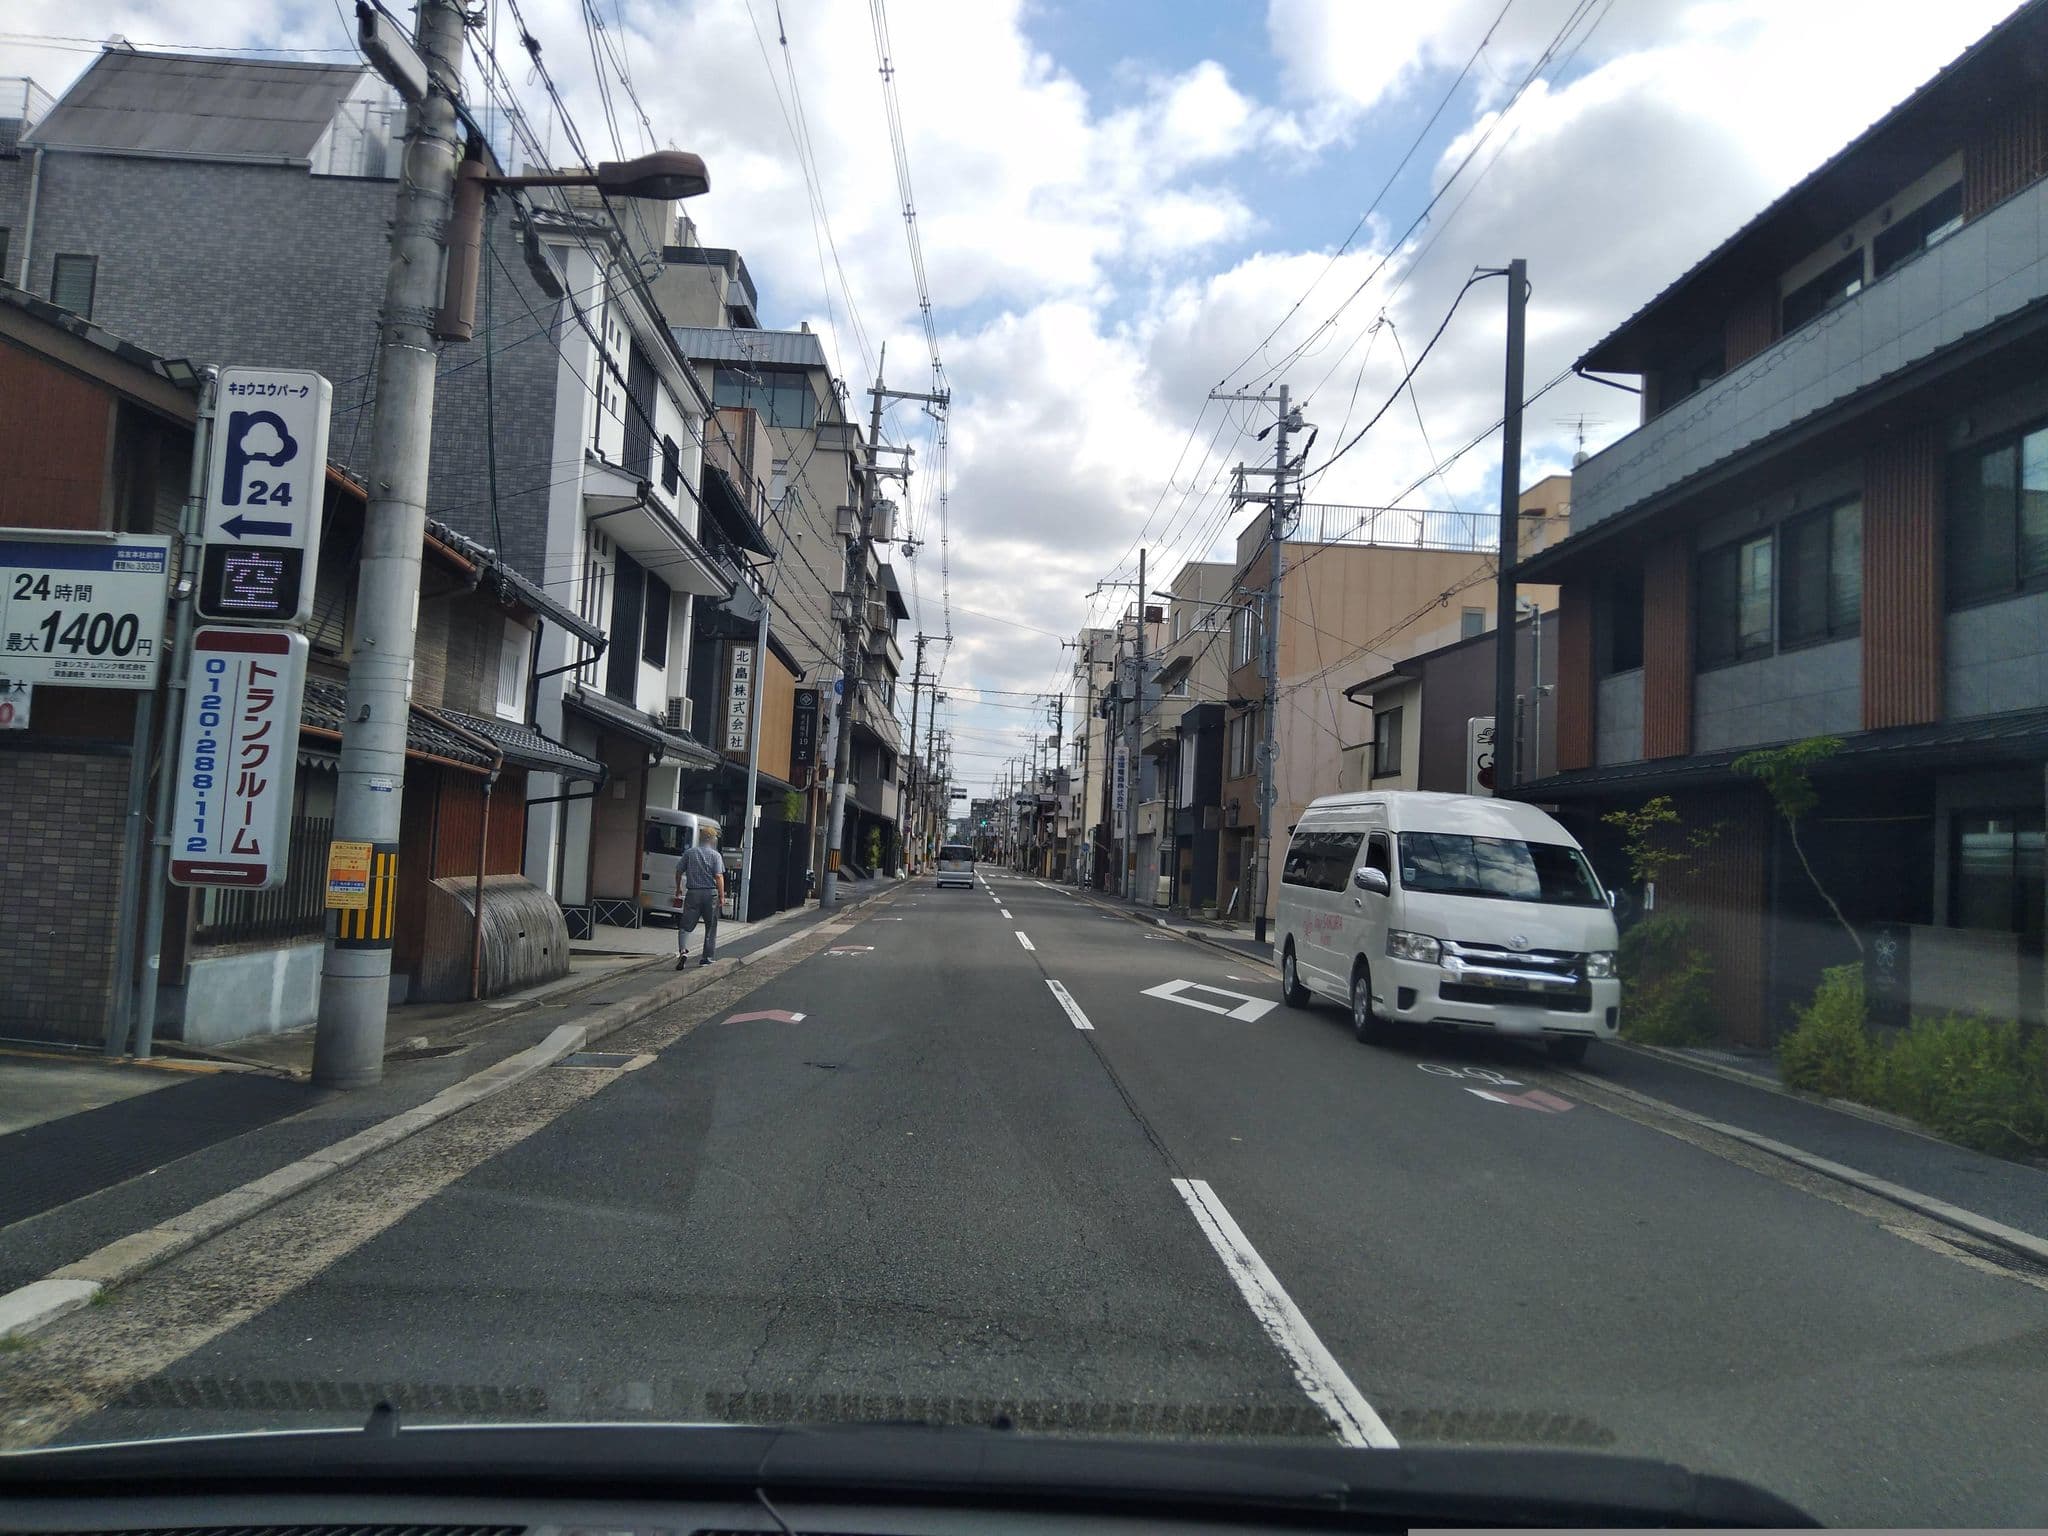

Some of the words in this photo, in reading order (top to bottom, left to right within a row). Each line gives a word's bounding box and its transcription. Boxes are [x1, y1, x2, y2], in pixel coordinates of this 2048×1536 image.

[228, 382, 309, 398] キョウユウパーク
[247, 480, 293, 506] 24
[730, 650, 750, 748] 北畠株式会社
[231, 660, 277, 855] トランクルーム
